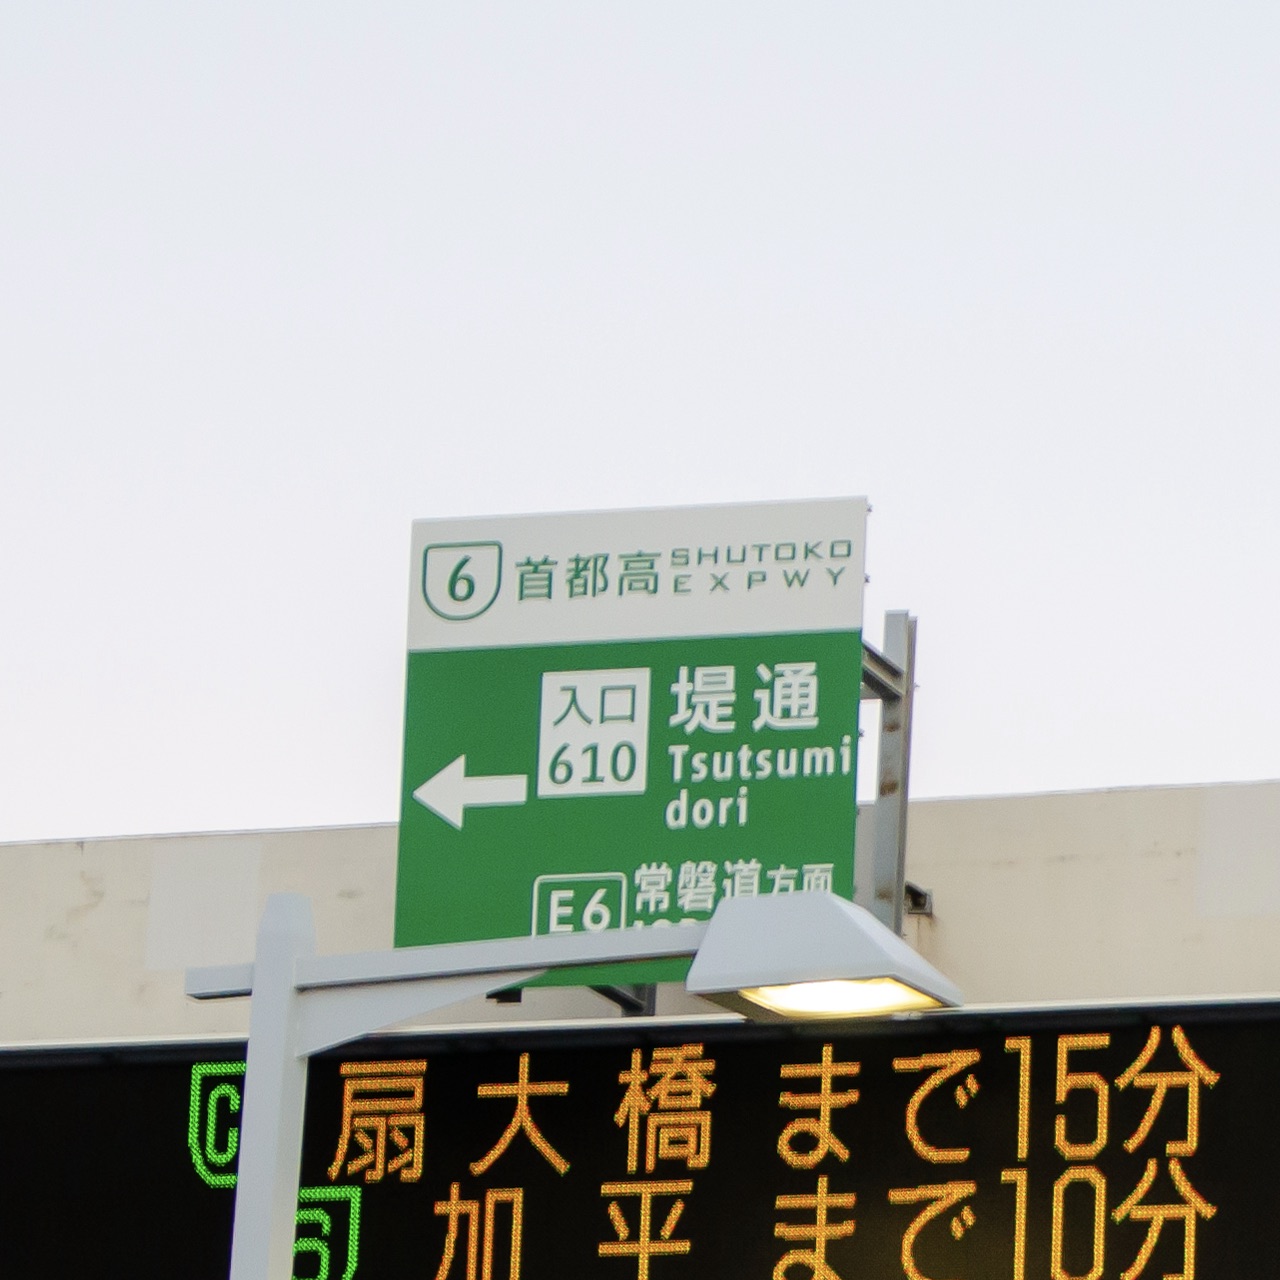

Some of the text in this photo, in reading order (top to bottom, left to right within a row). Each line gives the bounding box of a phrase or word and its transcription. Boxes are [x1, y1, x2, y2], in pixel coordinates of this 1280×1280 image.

[514, 549, 662, 601] 首都高
[671, 540, 853, 566] SHUTOKO
[448, 554, 477, 603] 6
[552, 684, 638, 727] 入口
[668, 660, 820, 735] 堤通
[547, 739, 637, 787] 610
[668, 734, 852, 784] Tsutsumi
[664, 786, 749, 830] dori
[549, 888, 611, 932] E6
[206, 1083, 241, 1166] C
